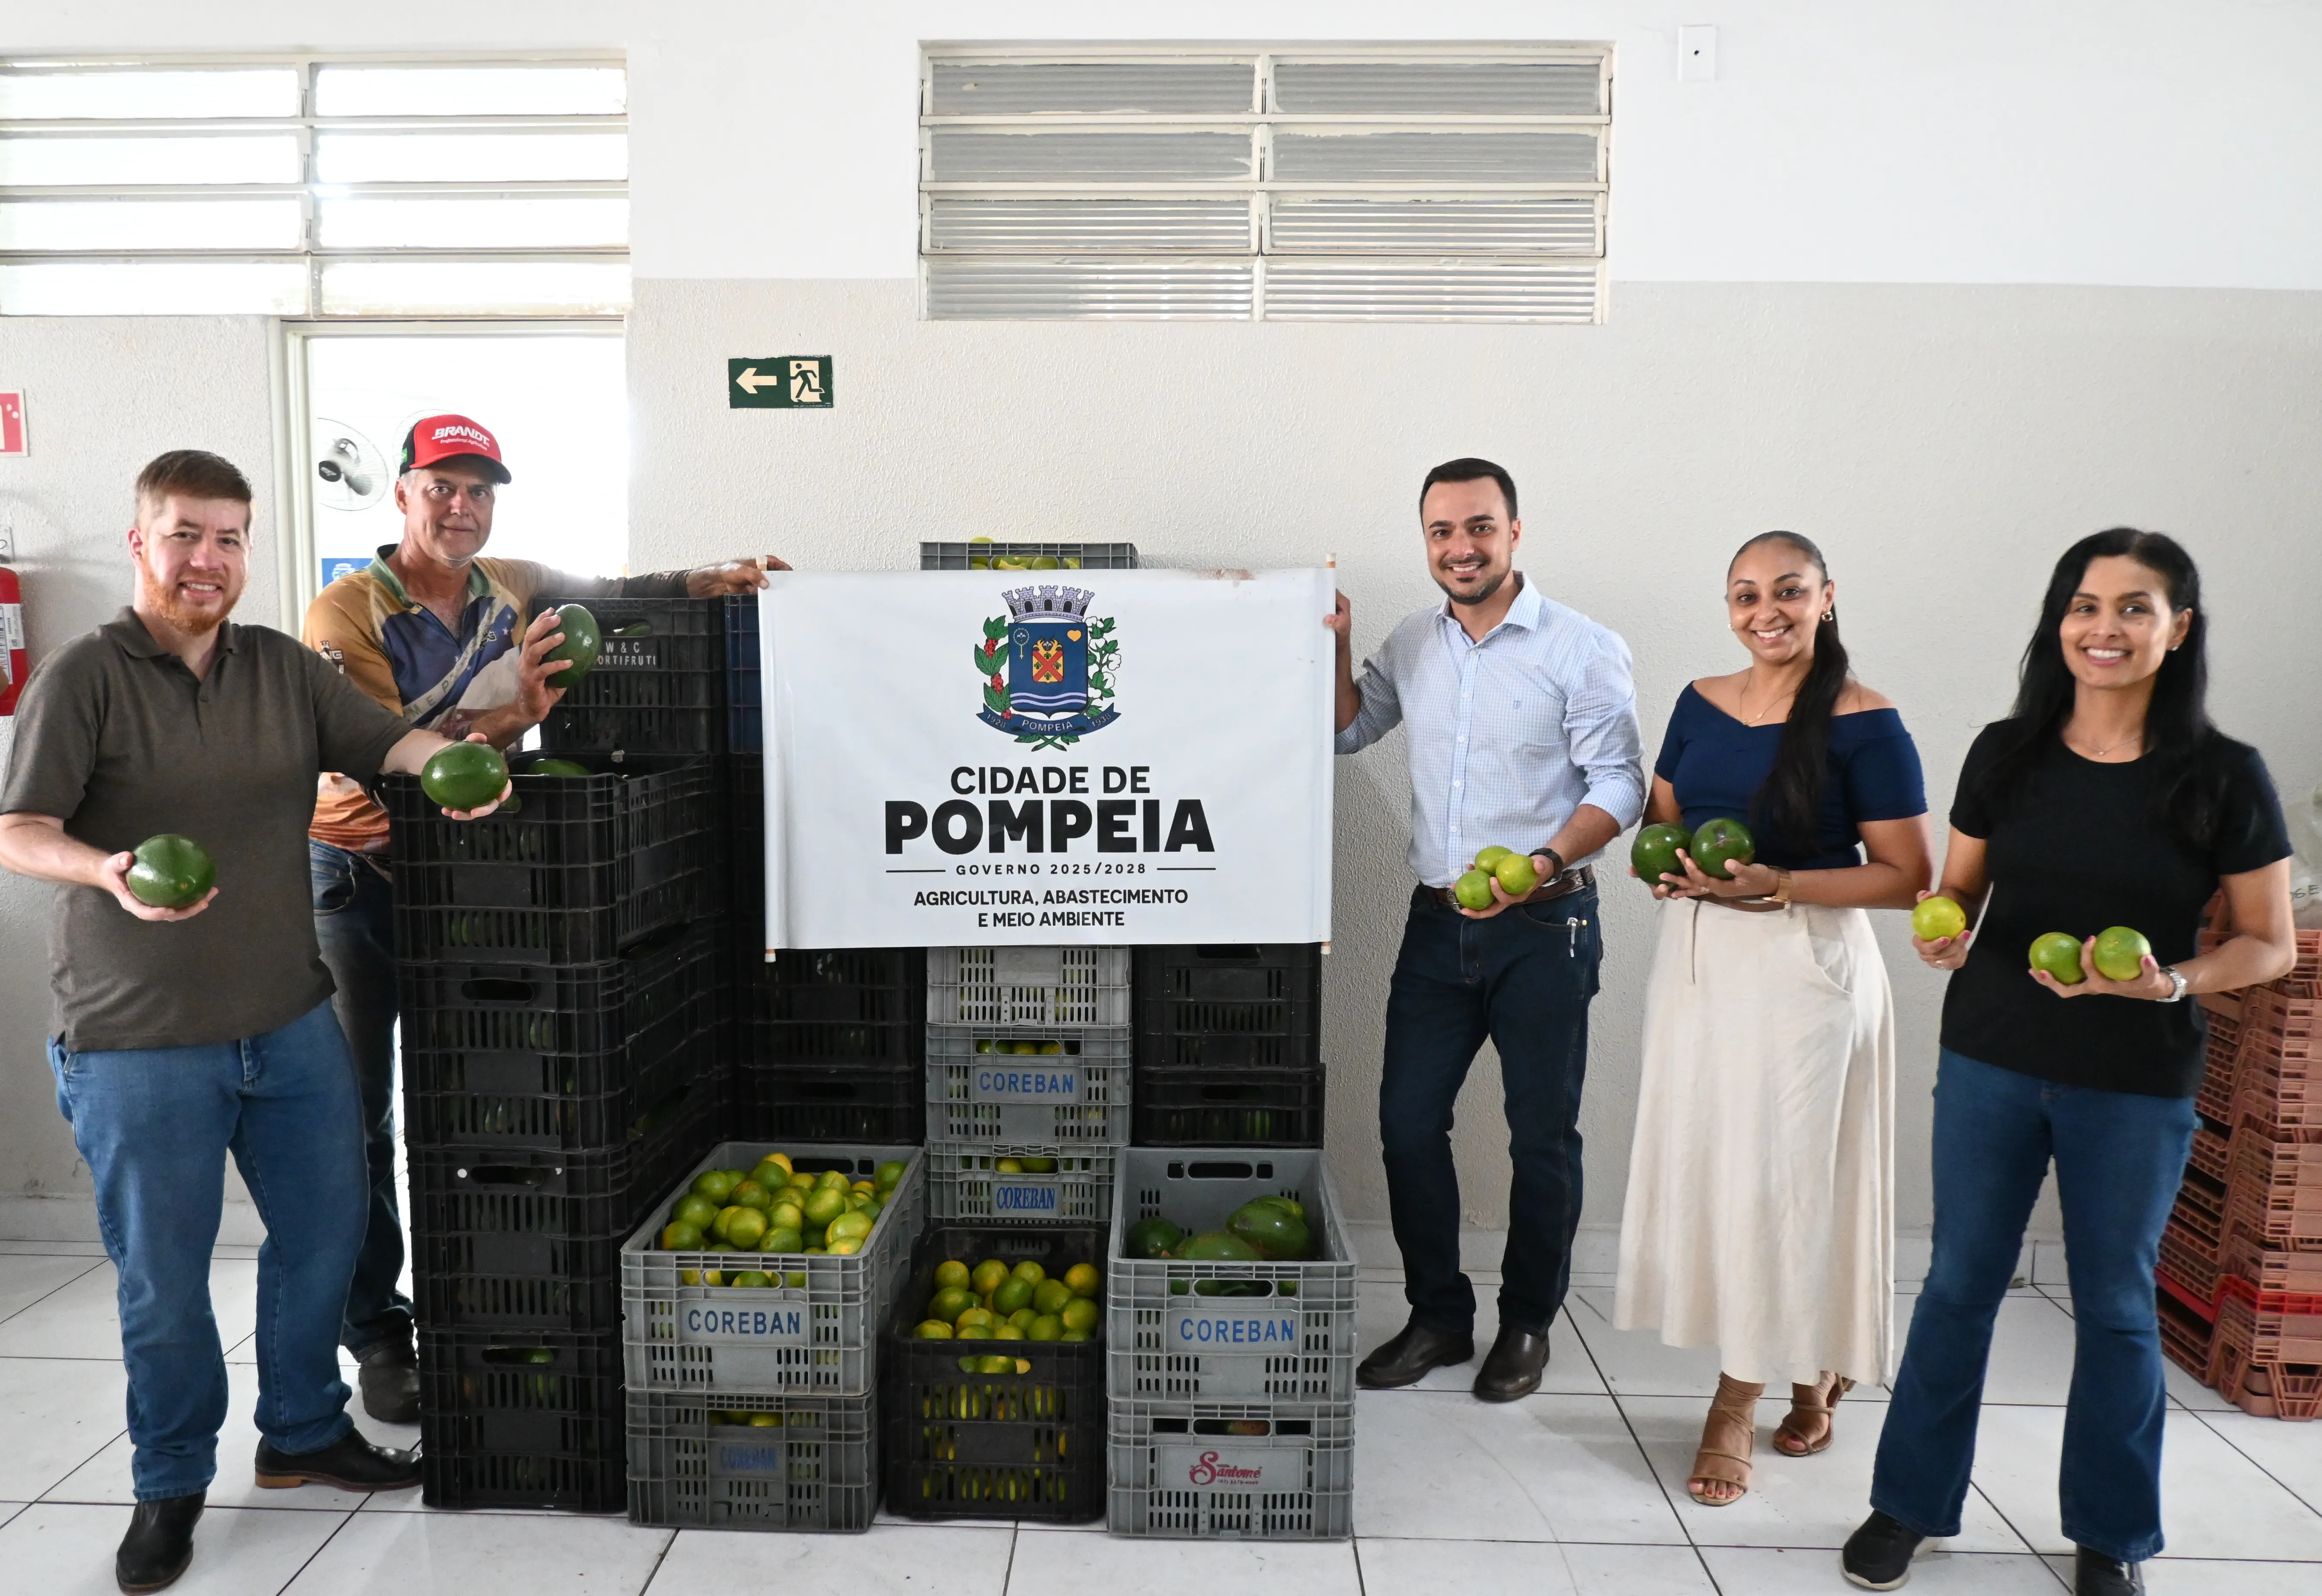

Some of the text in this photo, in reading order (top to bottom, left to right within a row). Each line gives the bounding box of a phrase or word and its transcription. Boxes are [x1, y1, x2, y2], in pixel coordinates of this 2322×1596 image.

[431, 426, 489, 445] BRANDT
[605, 641, 640, 654] W & C
[597, 655, 656, 666] ORTIFRUTI
[986, 713, 1112, 732] 1928 POMPEIA 1938
[950, 766, 1150, 795] CIDADE DE
[885, 799, 1215, 855] POMPEIA
[956, 862, 1146, 875] GOVERNO 2025/2028
[913, 889, 1188, 906] AGRICULTURA, ABASTECIMENTO
[978, 911, 1125, 927] E MEIO AMBIENTE
[979, 1072, 1073, 1093] COREBAN
[996, 1187, 1055, 1209] COREBAN
[689, 1309, 800, 1334] COREBAN
[1181, 1318, 1294, 1343] COREBAN
